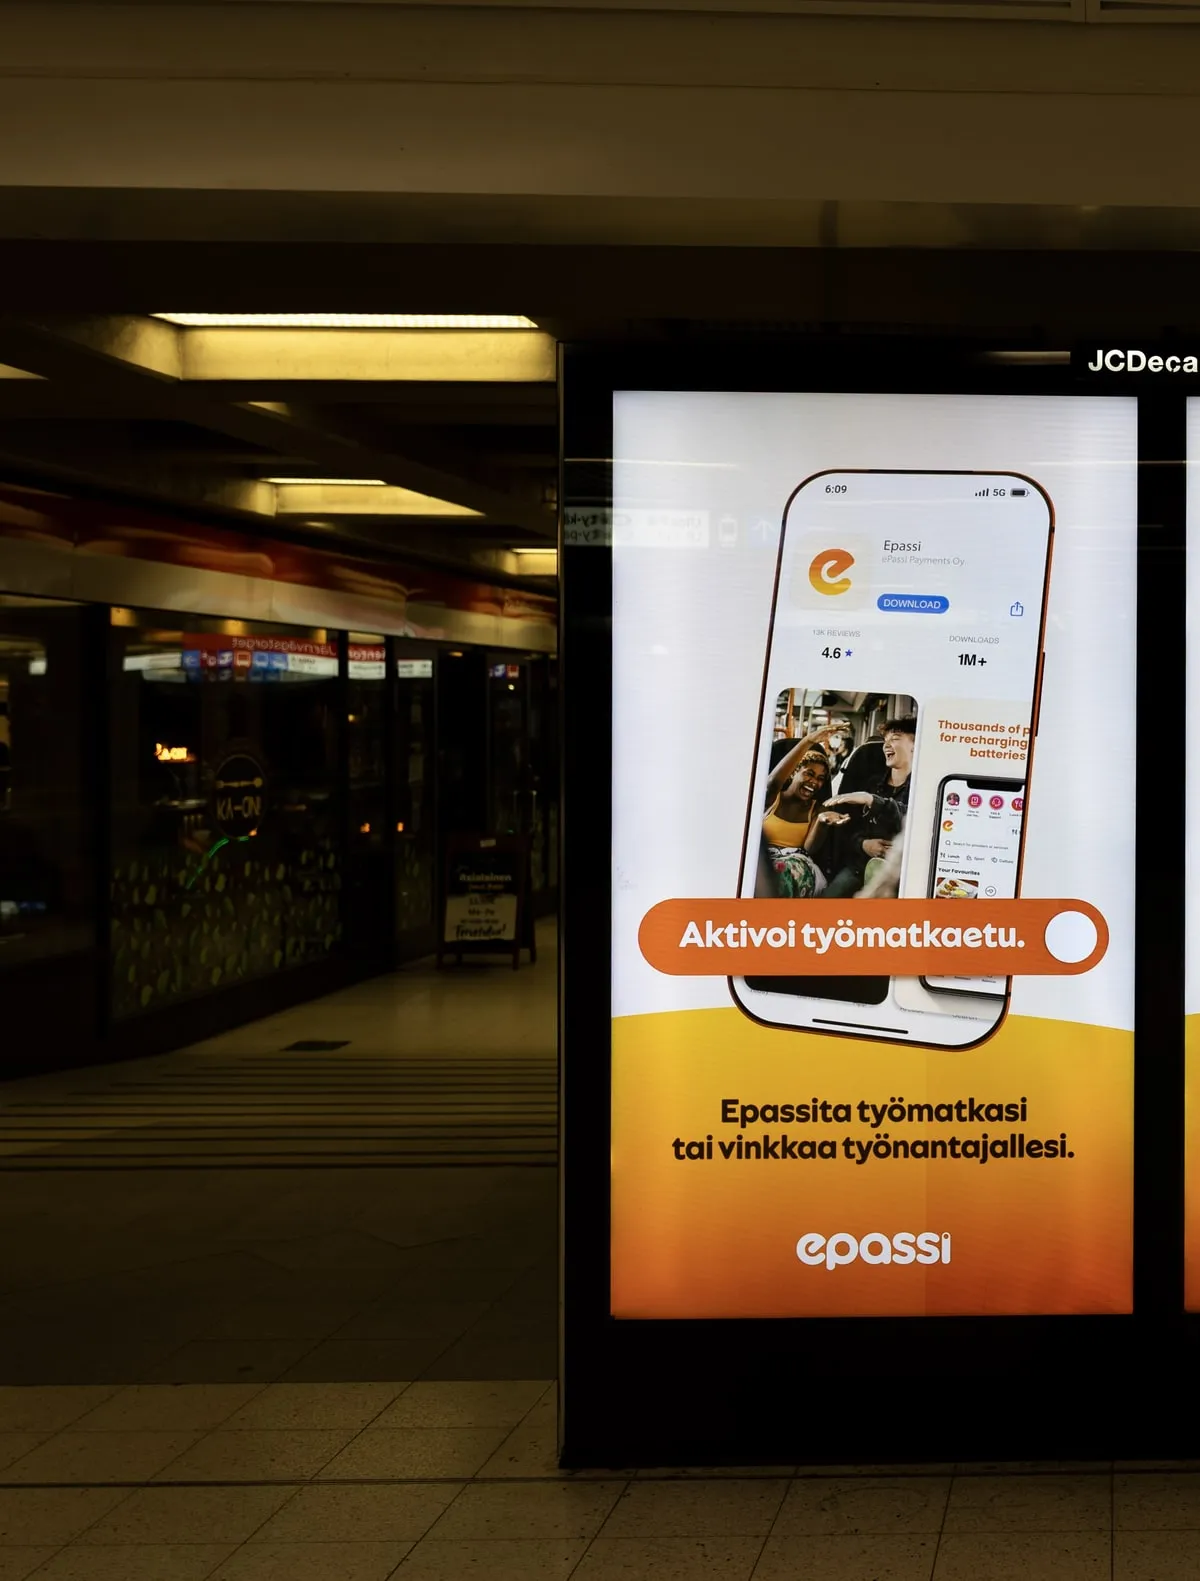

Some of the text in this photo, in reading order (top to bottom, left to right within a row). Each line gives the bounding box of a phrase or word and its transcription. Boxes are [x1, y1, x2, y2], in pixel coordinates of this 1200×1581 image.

[825, 485, 847, 494] 6:09
[993, 488, 1006, 497] 5G
[883, 540, 922, 553] Epassi
[881, 556, 966, 567] ePassi Payments Oy
[883, 598, 941, 609] DOWNLOAD
[827, 629, 861, 638] REVIEWS
[949, 635, 1000, 644] DOWNLOADS
[821, 647, 841, 659] 4.6
[957, 654, 987, 667] 1M+
[938, 720, 1005, 733] Thousands
[1008, 724, 1021, 734] of
[940, 732, 1028, 750] for recharging
[970, 748, 1026, 760] batteries
[952, 868, 980, 876] Favourites
[679, 919, 1025, 954] Aktivoi työmatkaetu.
[721, 1096, 1028, 1128] Epassita työmatkasi
[672, 1133, 1075, 1164] tai vinkkaa työnantajallesi.
[796, 1231, 951, 1271] epassi
